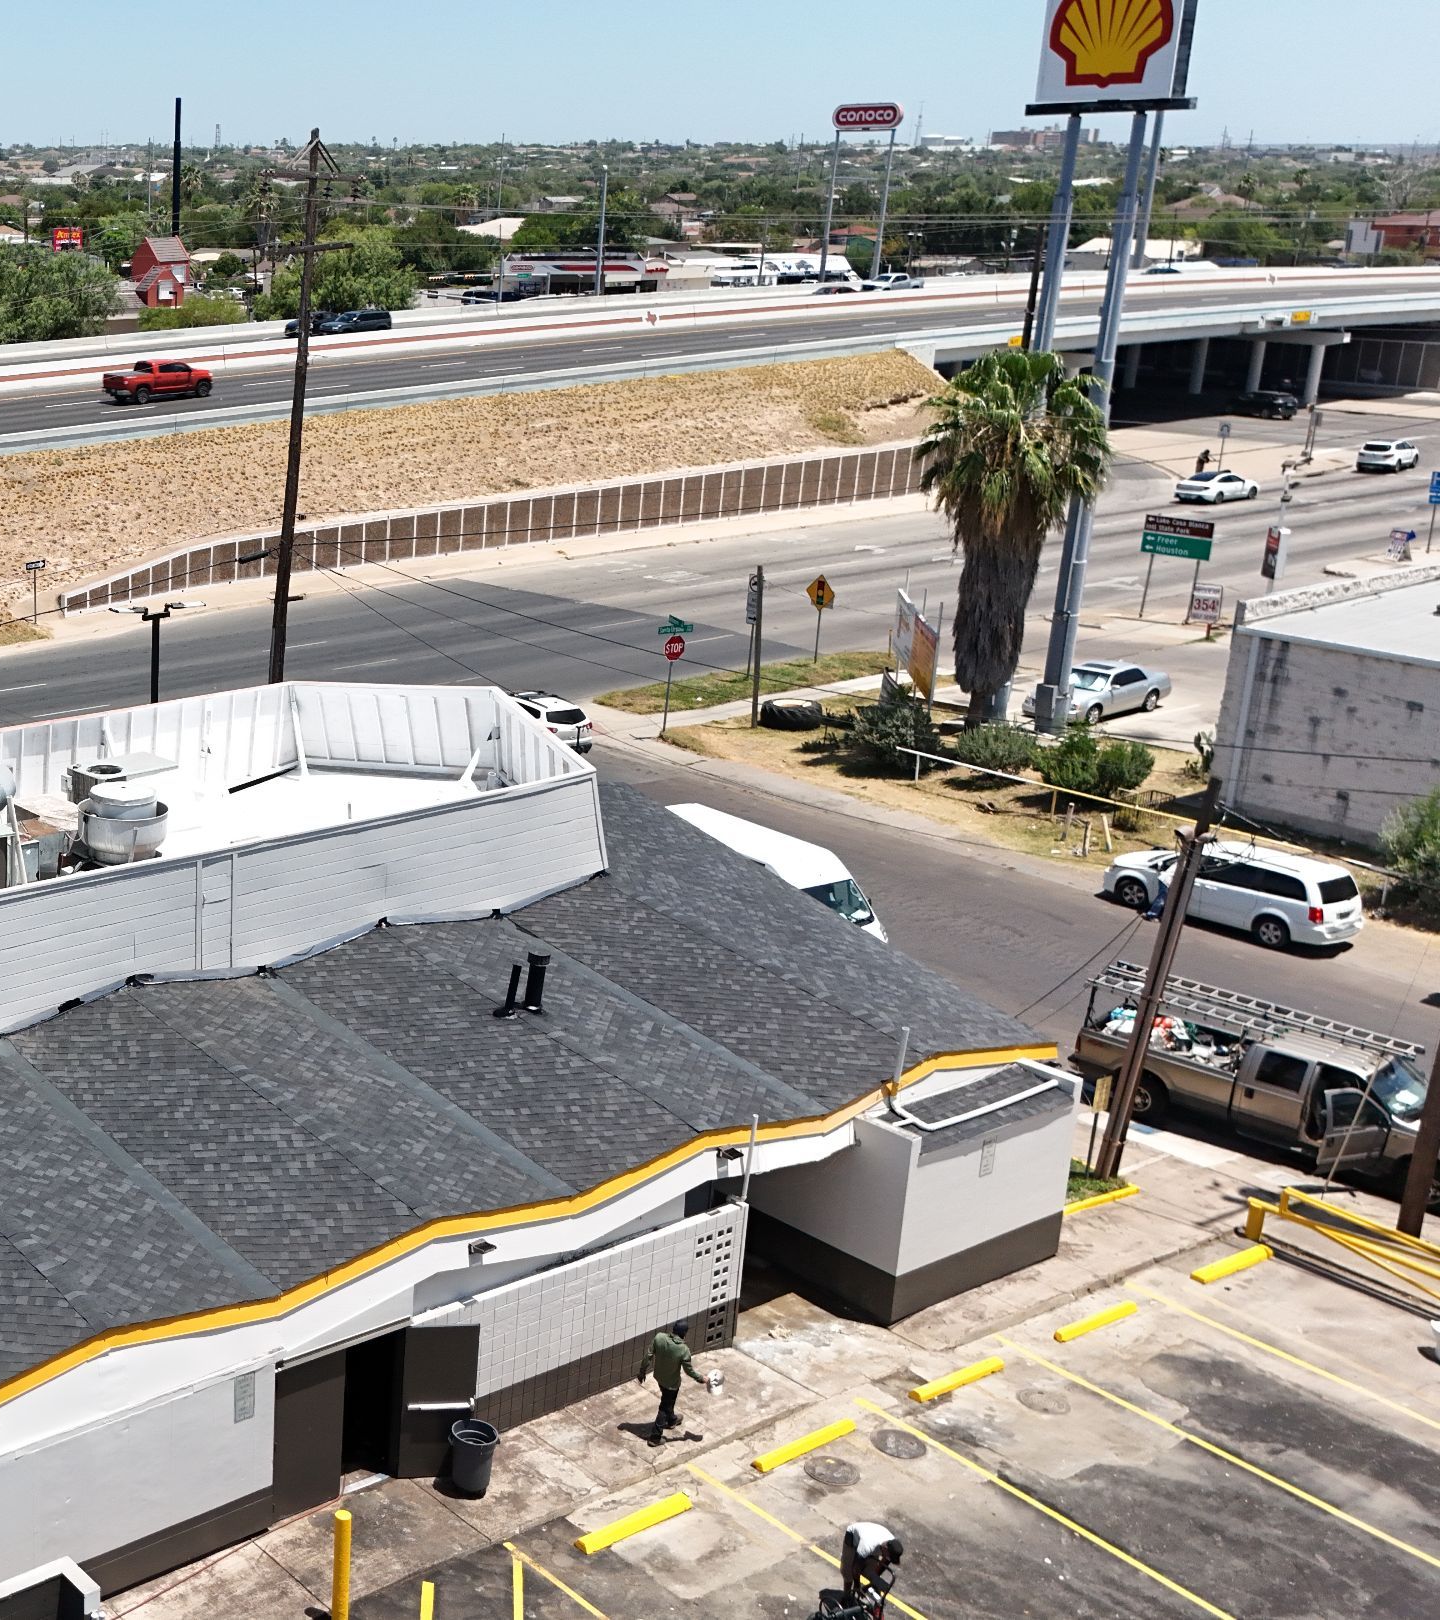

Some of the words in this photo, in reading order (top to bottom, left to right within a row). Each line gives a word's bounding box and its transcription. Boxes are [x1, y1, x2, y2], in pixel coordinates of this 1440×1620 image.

[56, 230, 80, 239] Amex
[1156, 535, 1178, 545] Freer
[1155, 544, 1188, 556] Houston
[665, 643, 683, 654] STOP
